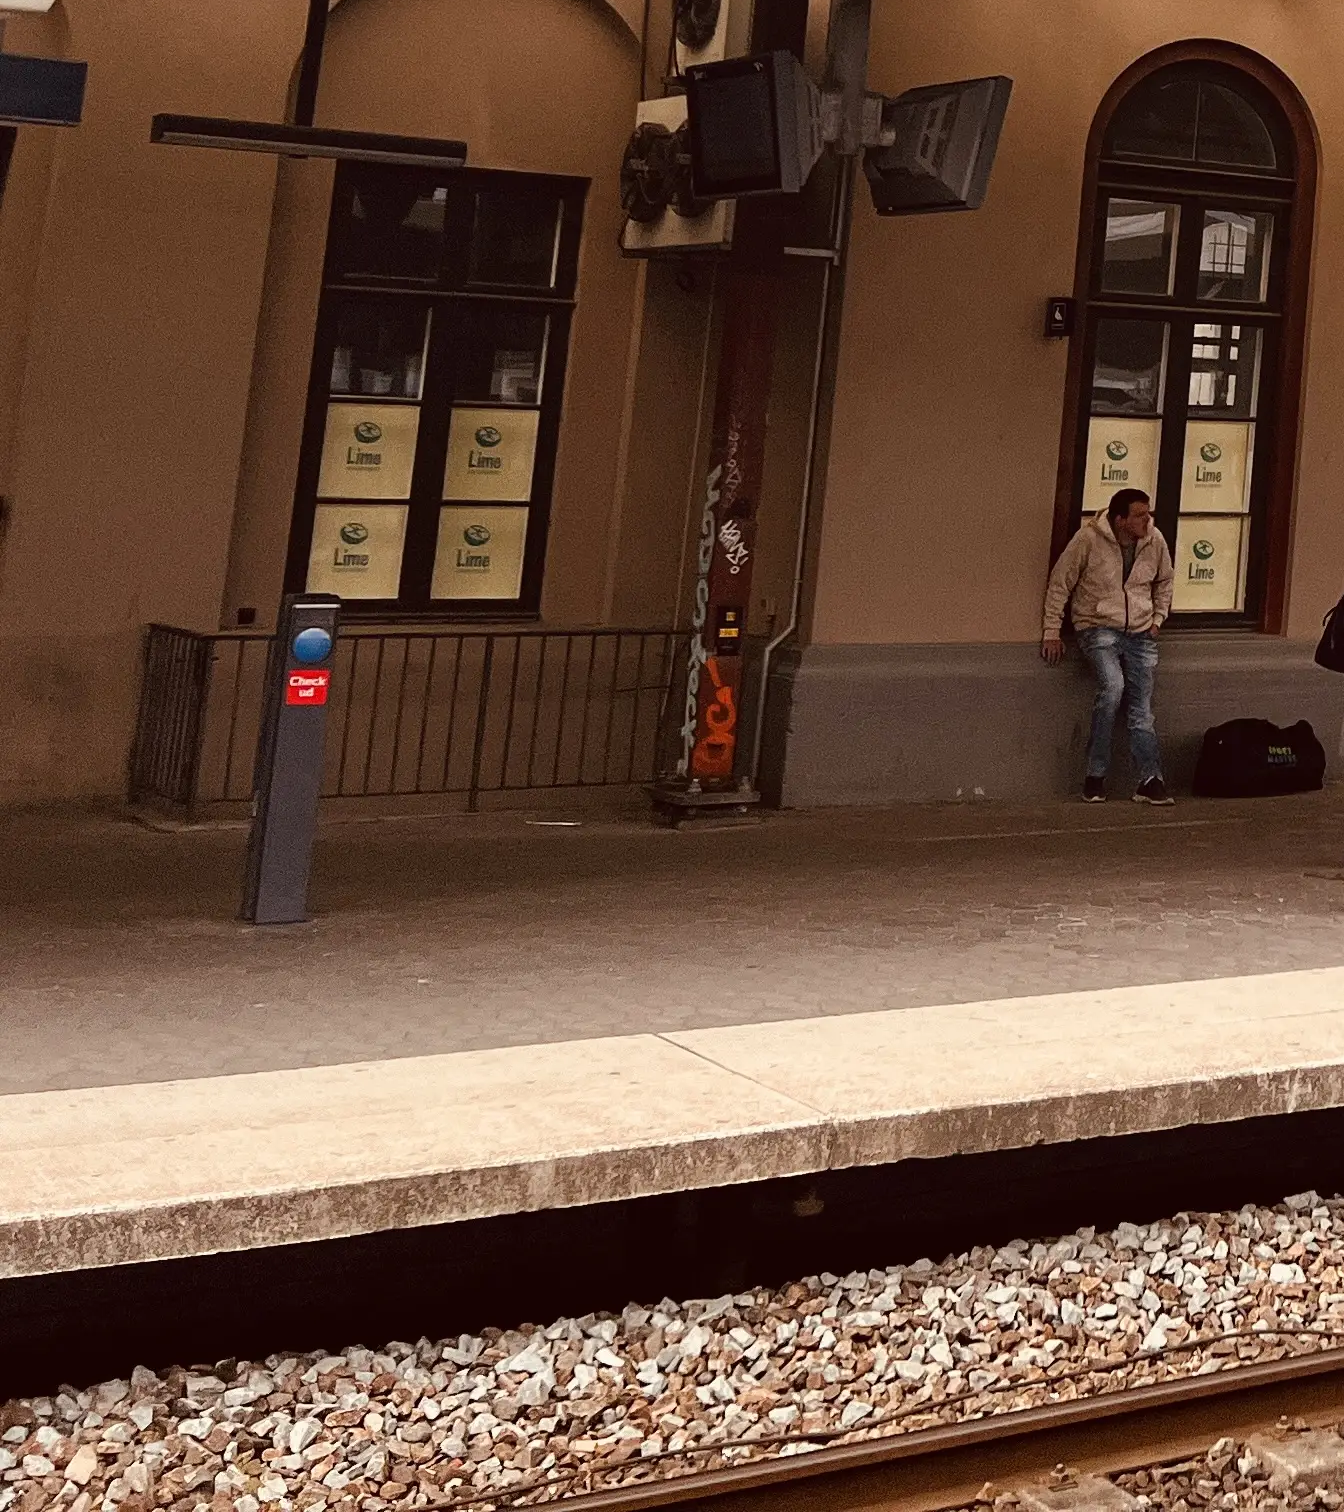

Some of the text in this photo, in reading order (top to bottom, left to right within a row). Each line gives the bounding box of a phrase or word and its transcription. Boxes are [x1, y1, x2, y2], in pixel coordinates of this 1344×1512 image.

[346, 447, 381, 466] Lime
[468, 450, 501, 468] Lime
[1101, 463, 1129, 481] Lime
[1196, 465, 1222, 483] Lime
[334, 548, 369, 567] Lime
[456, 550, 490, 568] Lime
[1188, 562, 1215, 580] Lime
[290, 676, 328, 686] Check
[299, 687, 315, 697] ud
